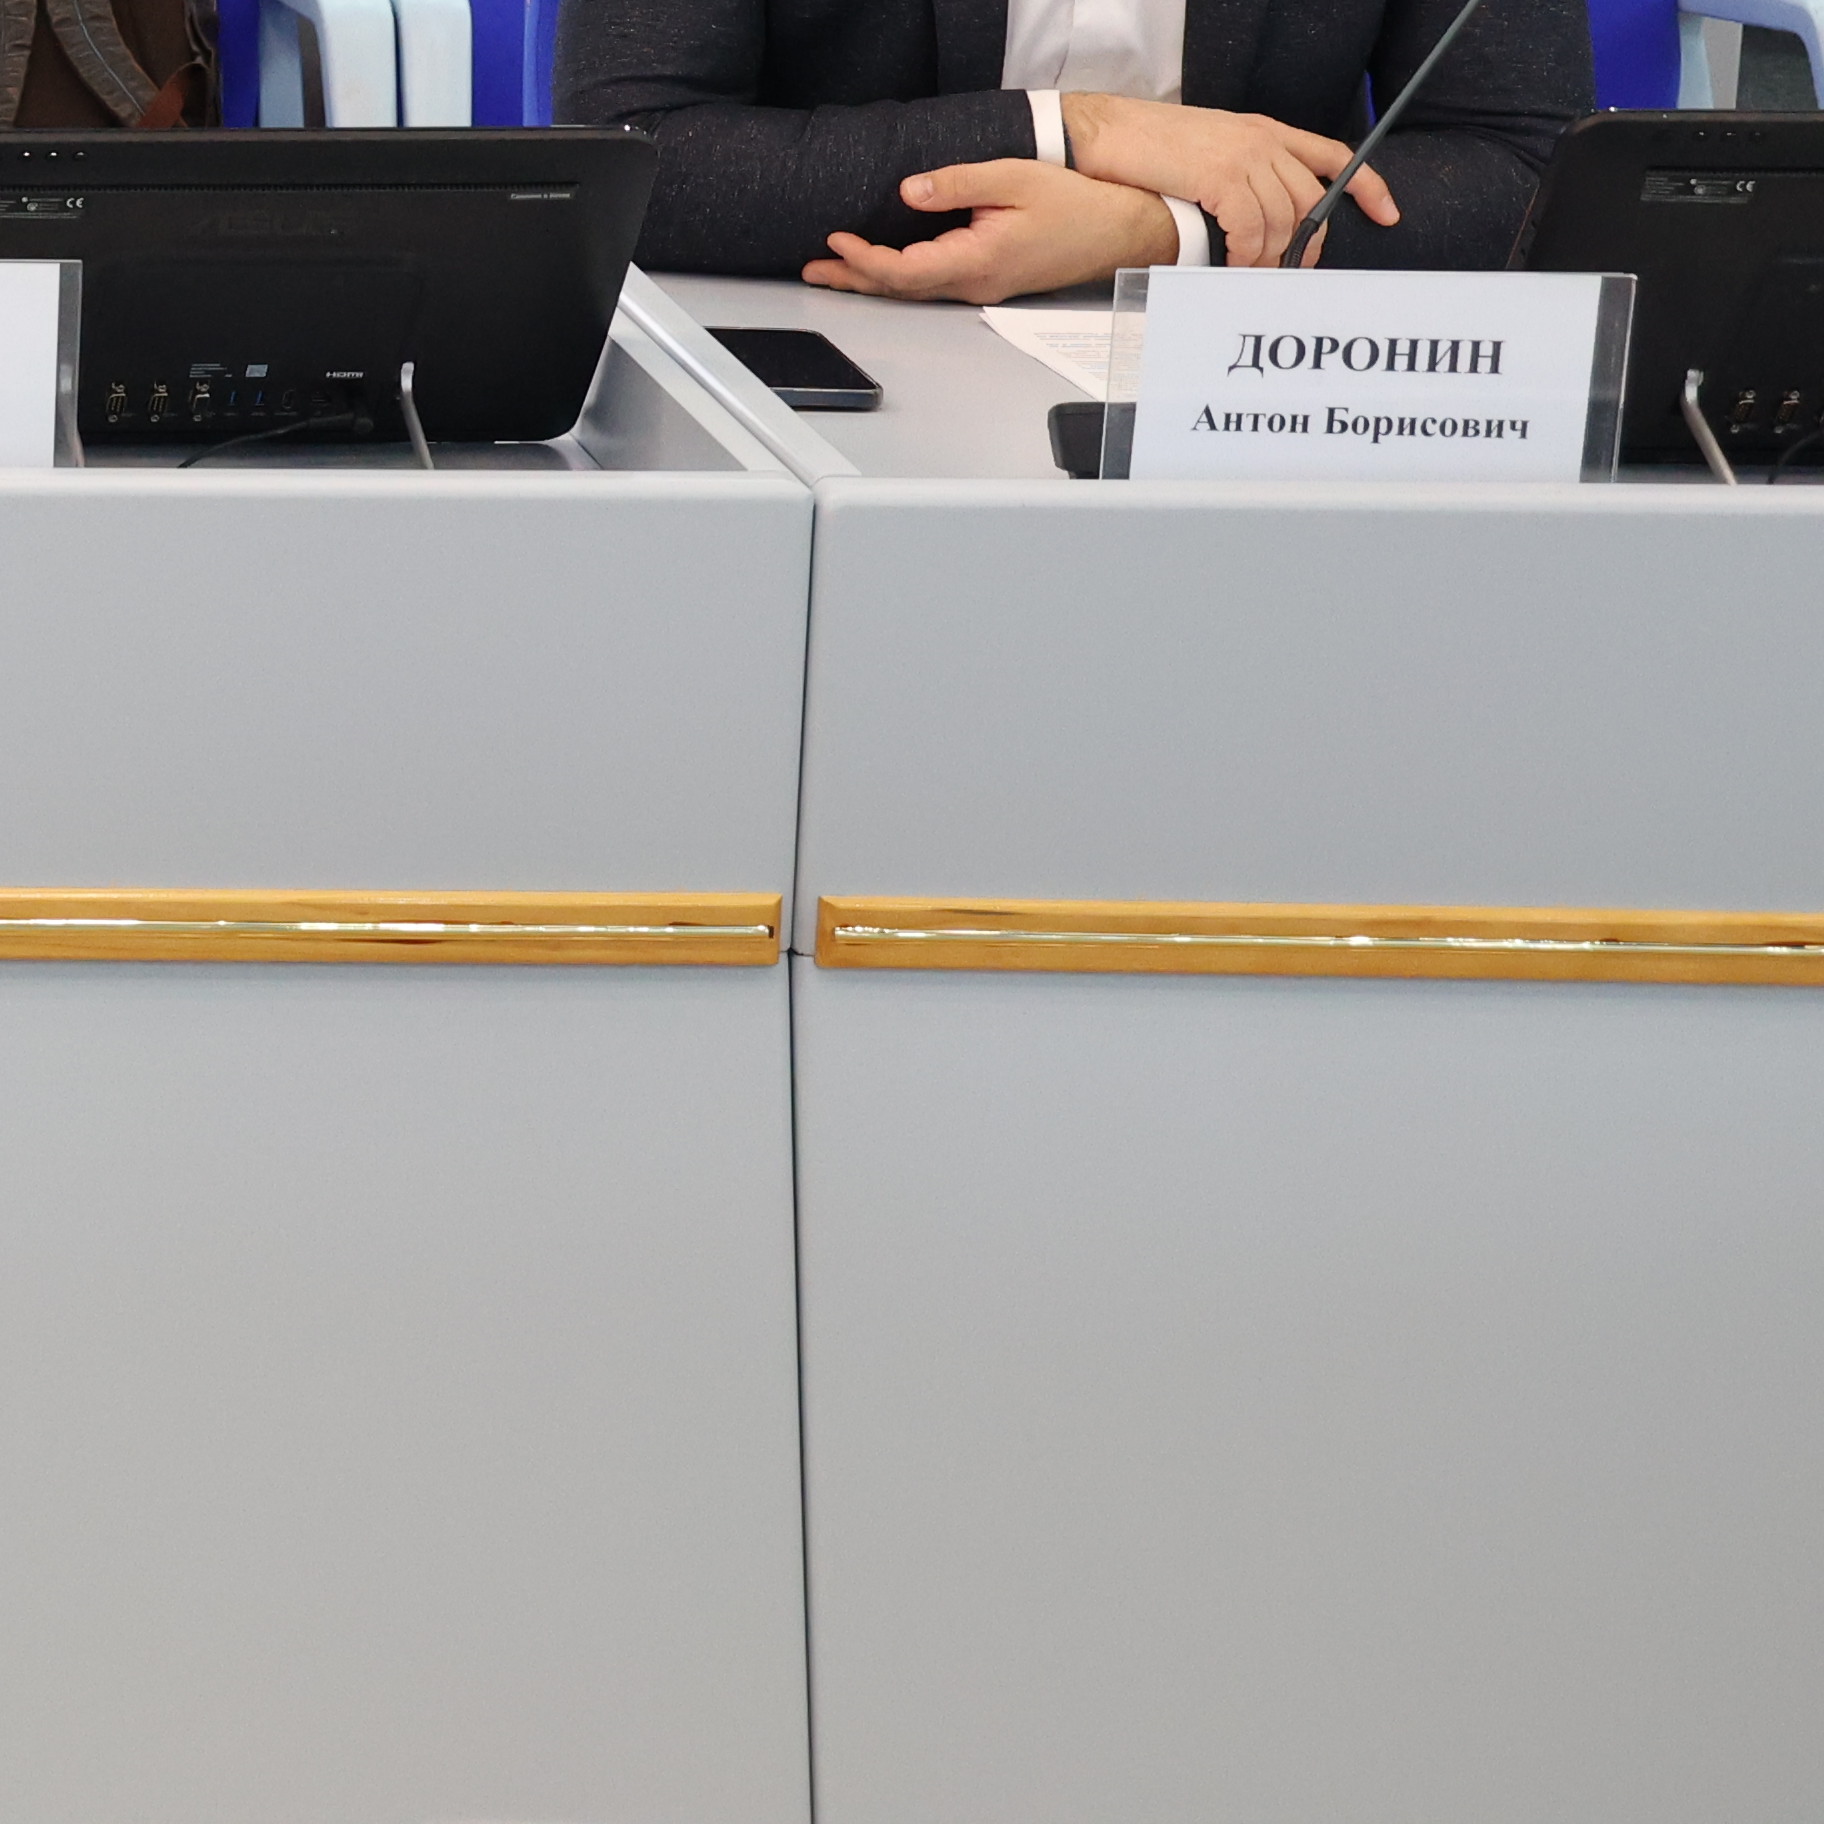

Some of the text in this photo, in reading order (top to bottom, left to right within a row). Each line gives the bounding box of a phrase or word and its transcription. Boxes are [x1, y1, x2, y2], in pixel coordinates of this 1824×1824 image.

[1228, 335, 1503, 376] ДОРОНИН
[1192, 405, 1528, 444] Антон Борисович
